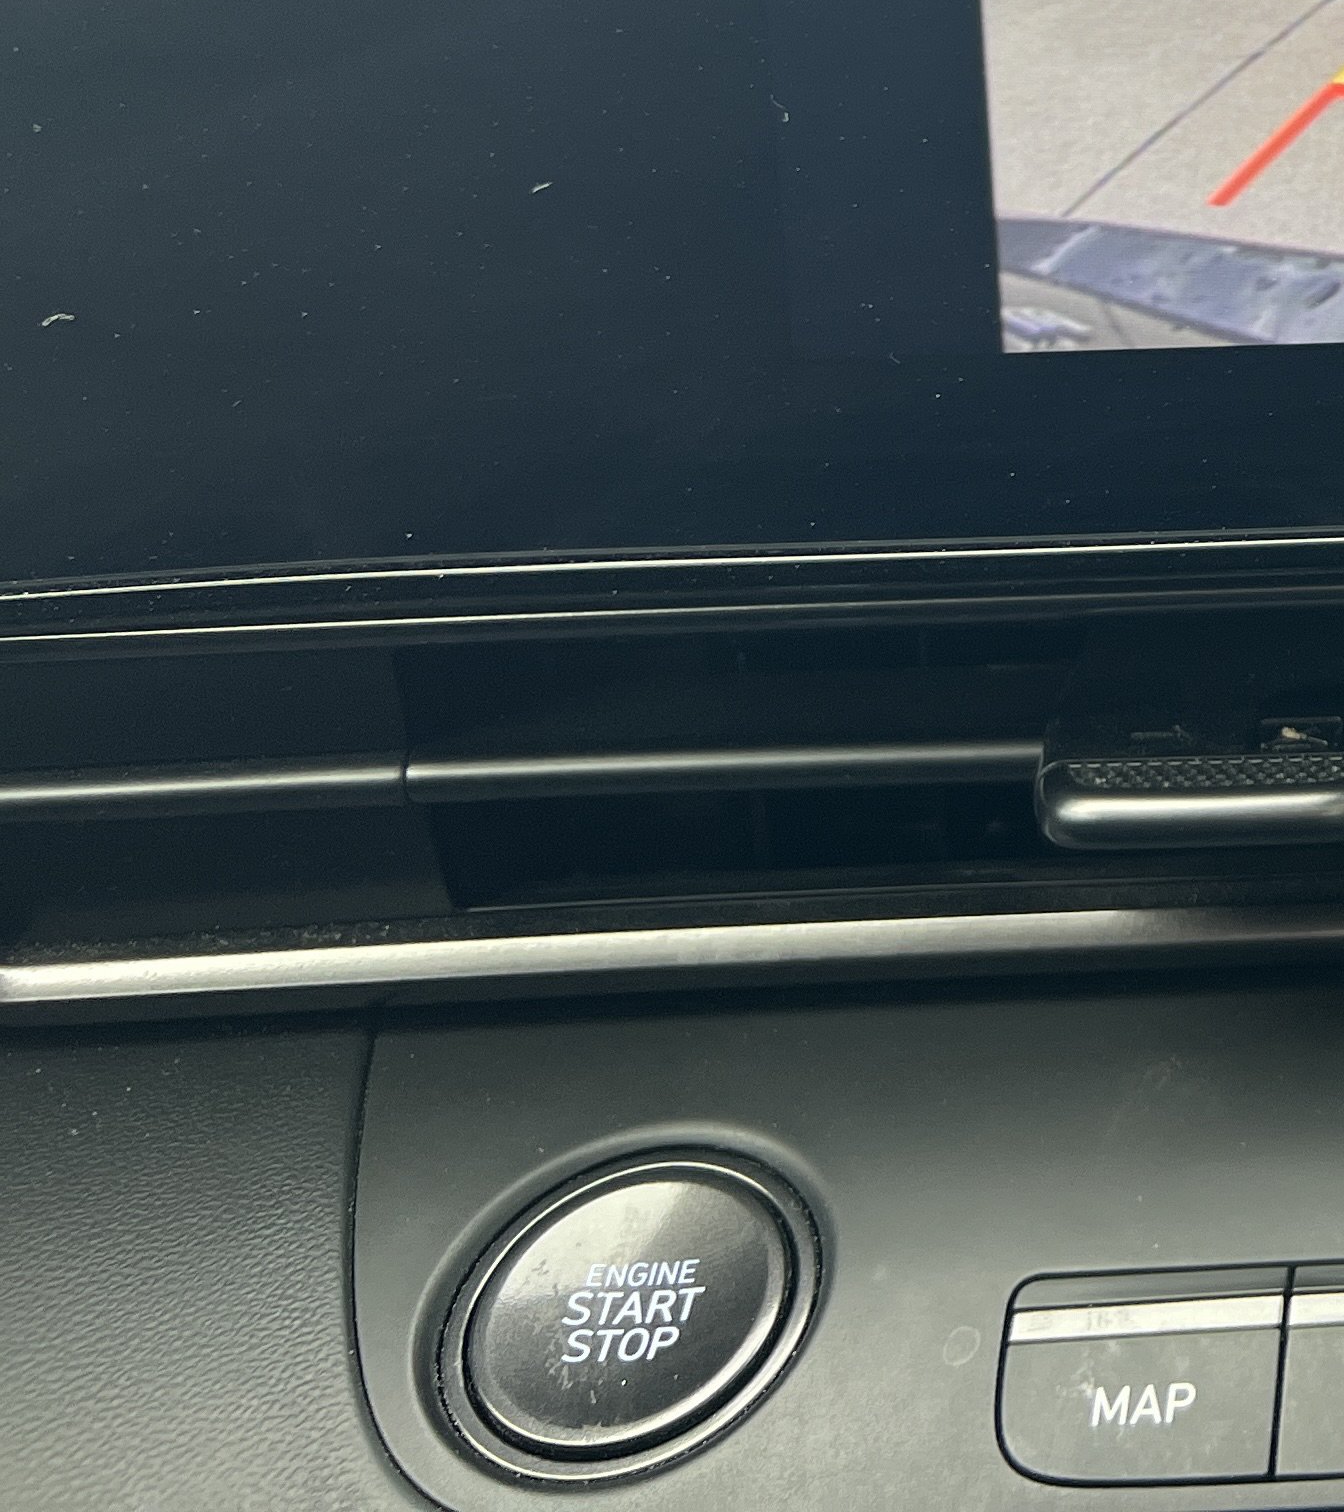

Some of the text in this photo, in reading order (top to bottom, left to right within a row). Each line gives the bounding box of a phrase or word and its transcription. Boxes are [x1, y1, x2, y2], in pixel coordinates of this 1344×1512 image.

[585, 1259, 701, 1286] ENGINE
[561, 1286, 705, 1326] START
[561, 1326, 681, 1364] STOP
[1088, 1381, 1198, 1428] MAP
